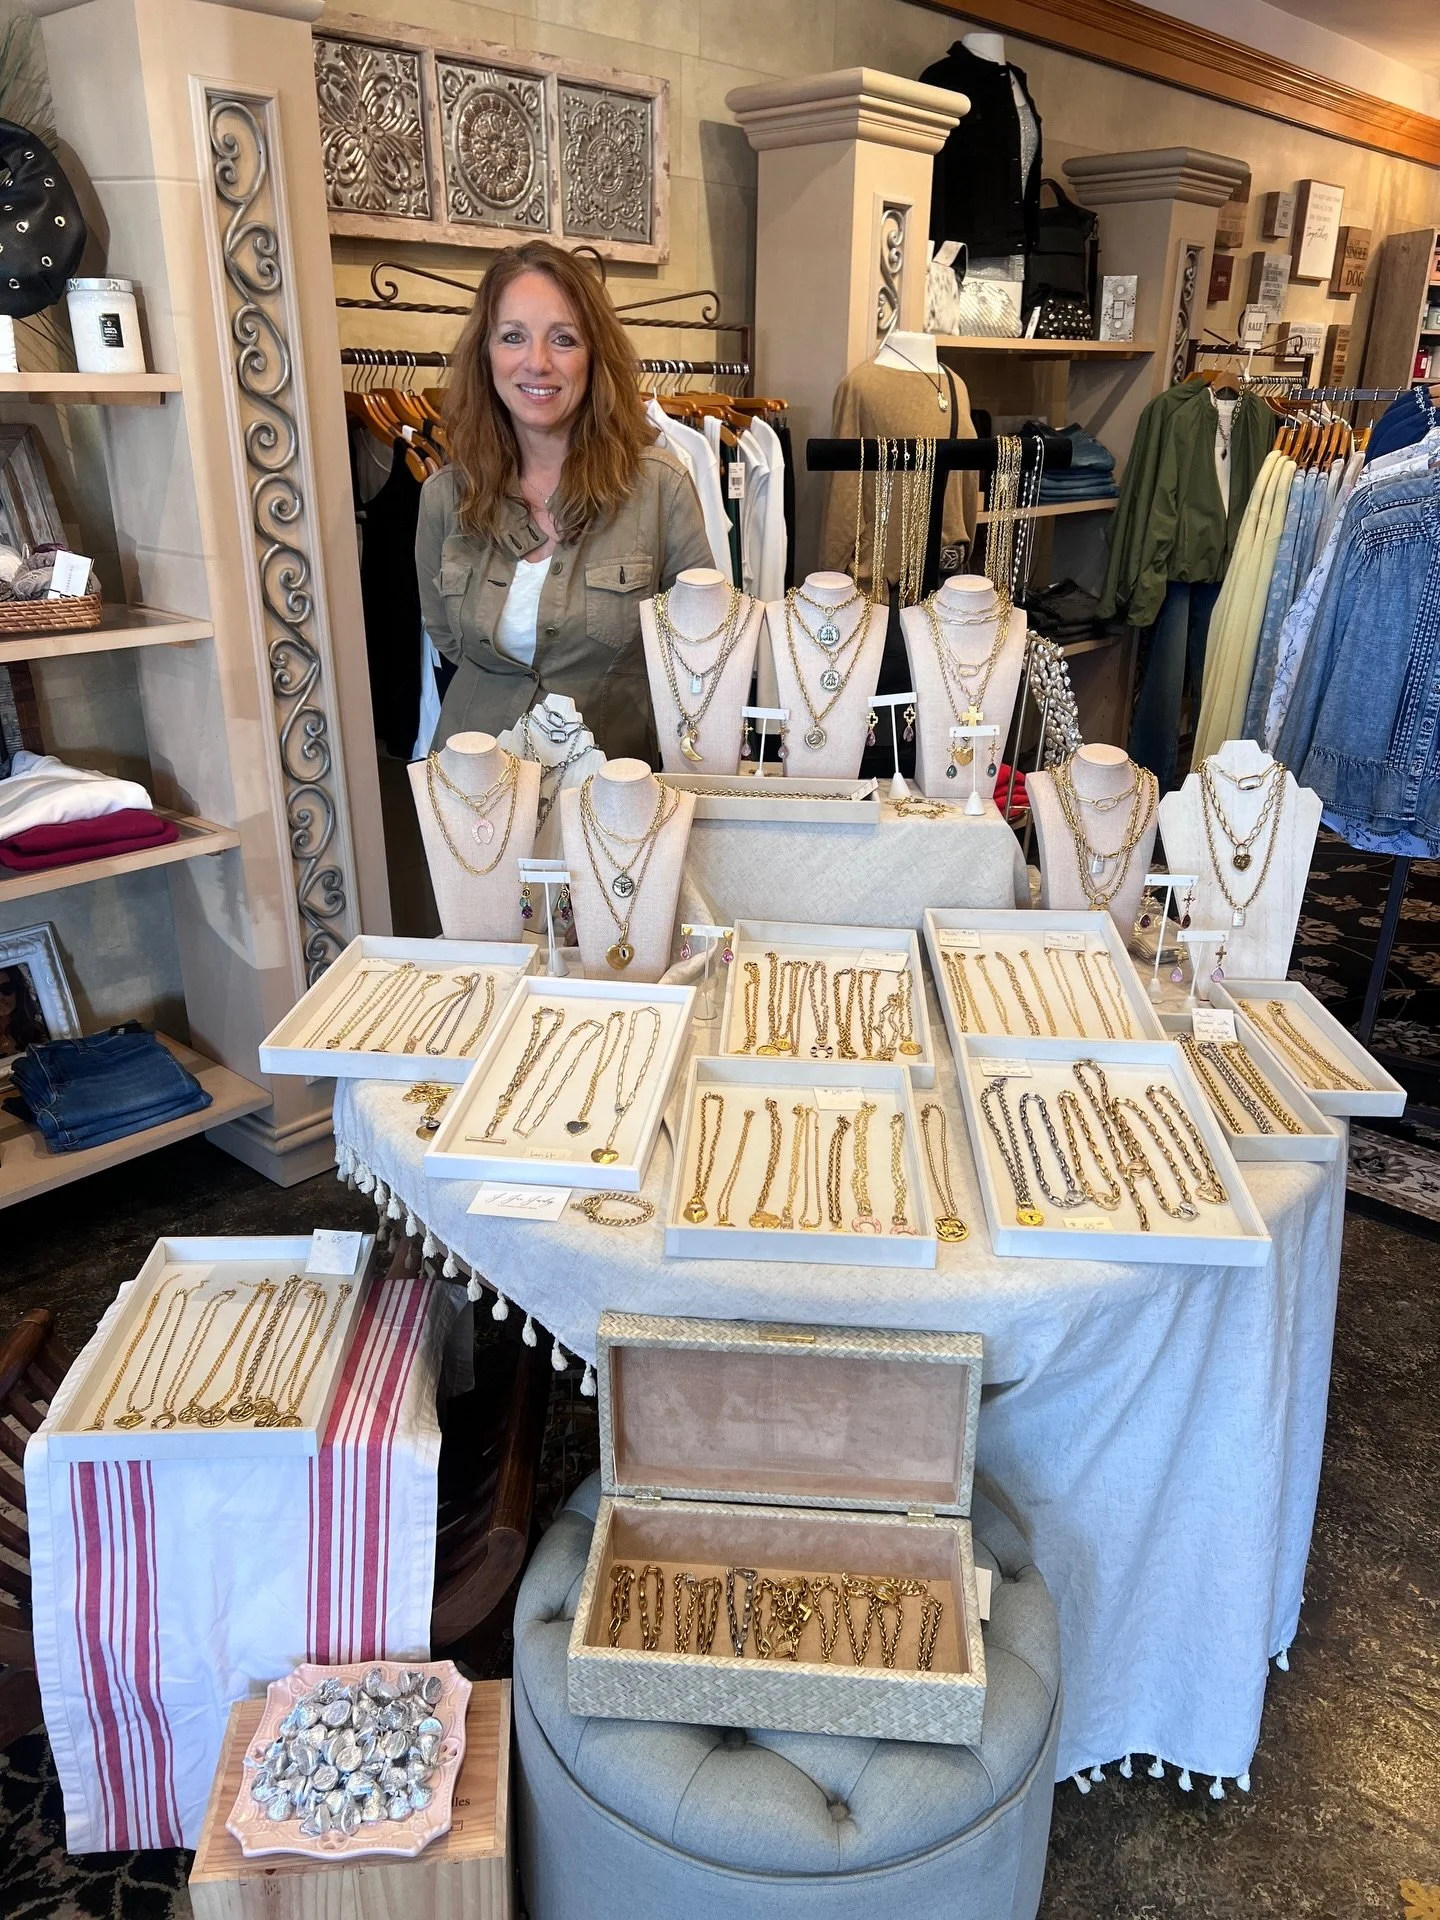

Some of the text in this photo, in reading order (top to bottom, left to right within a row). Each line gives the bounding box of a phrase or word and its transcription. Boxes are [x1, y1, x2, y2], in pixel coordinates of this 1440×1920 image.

[1345, 245, 1368, 260] SINGLE
[1345, 270, 1364, 287] DOG
[1247, 322, 1263, 331] SALE
